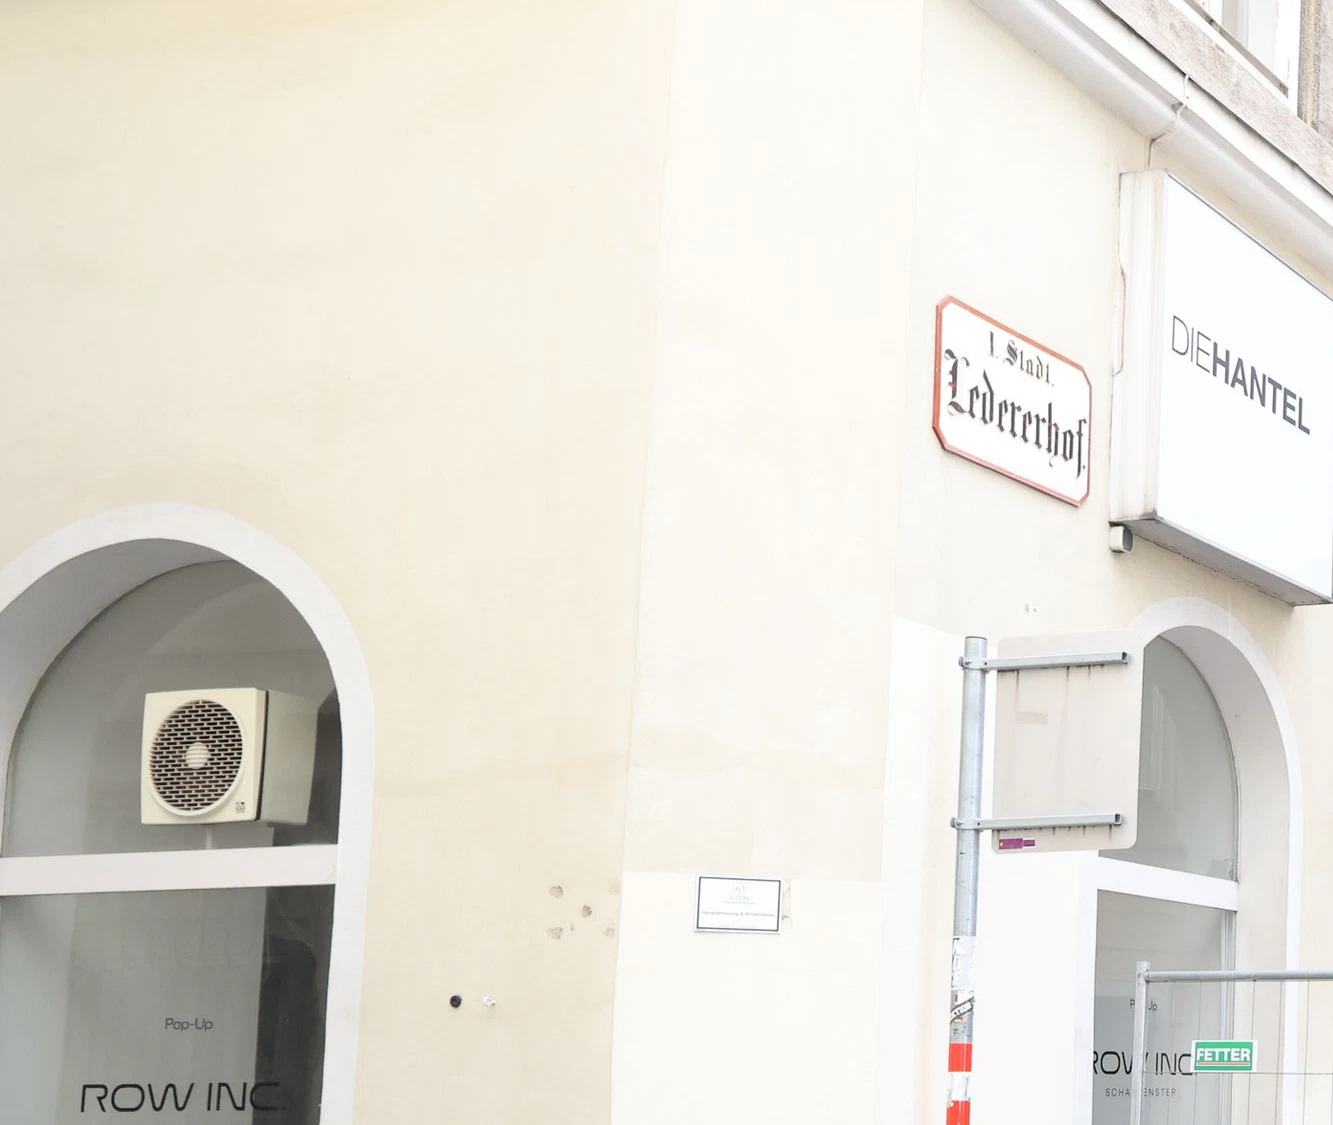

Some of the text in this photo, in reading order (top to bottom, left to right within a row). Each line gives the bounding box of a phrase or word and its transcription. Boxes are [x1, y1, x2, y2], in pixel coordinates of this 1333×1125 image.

[1171, 314, 1311, 435] DIEHANTEL
[164, 1017, 214, 1032] Pop-Up
[1196, 1048, 1251, 1062] FETTER
[81, 1082, 195, 1113] ROW
